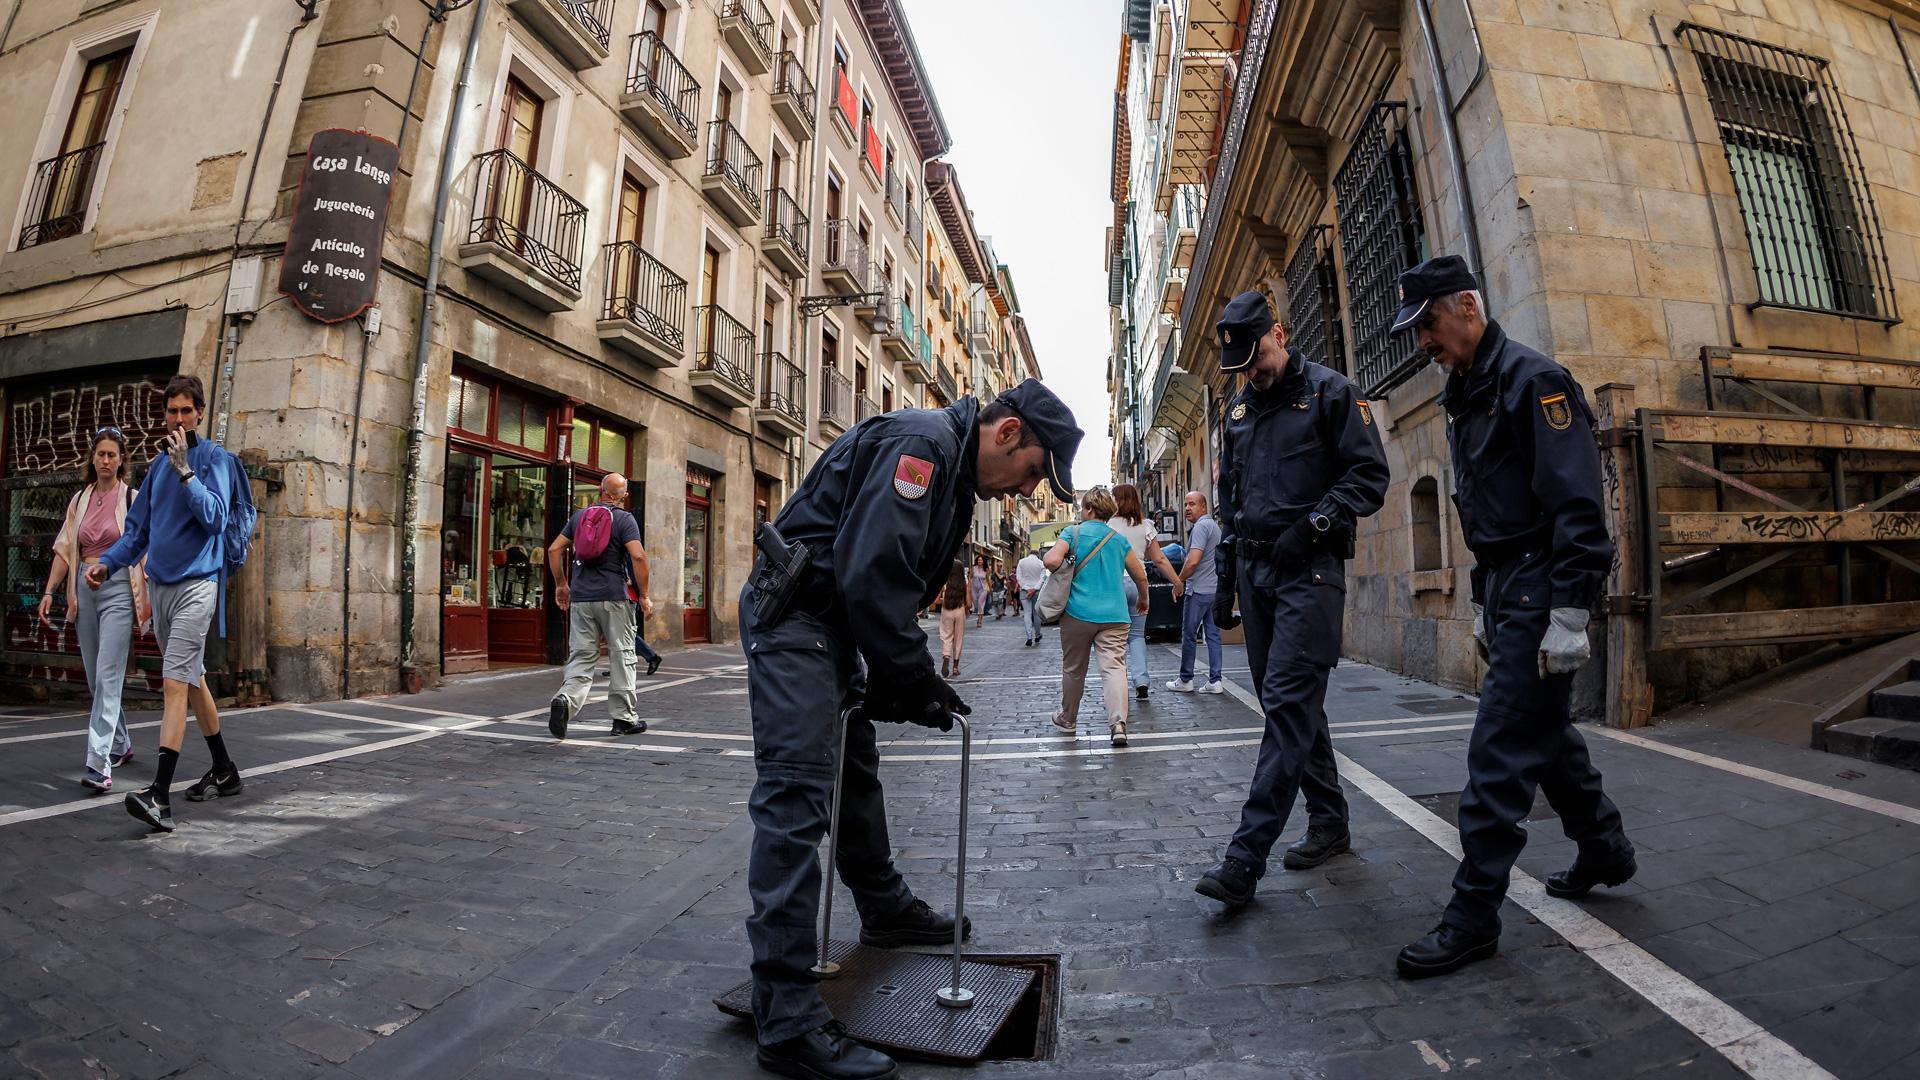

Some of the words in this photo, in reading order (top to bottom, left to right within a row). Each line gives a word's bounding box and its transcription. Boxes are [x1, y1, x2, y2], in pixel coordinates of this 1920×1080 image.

[312, 155, 348, 172] Casa
[354, 155, 391, 185] Lange
[313, 198, 375, 220] Juguetería
[311, 238, 365, 258] Artículos
[302, 260, 320, 274] de
[324, 263, 366, 282] Regalo
